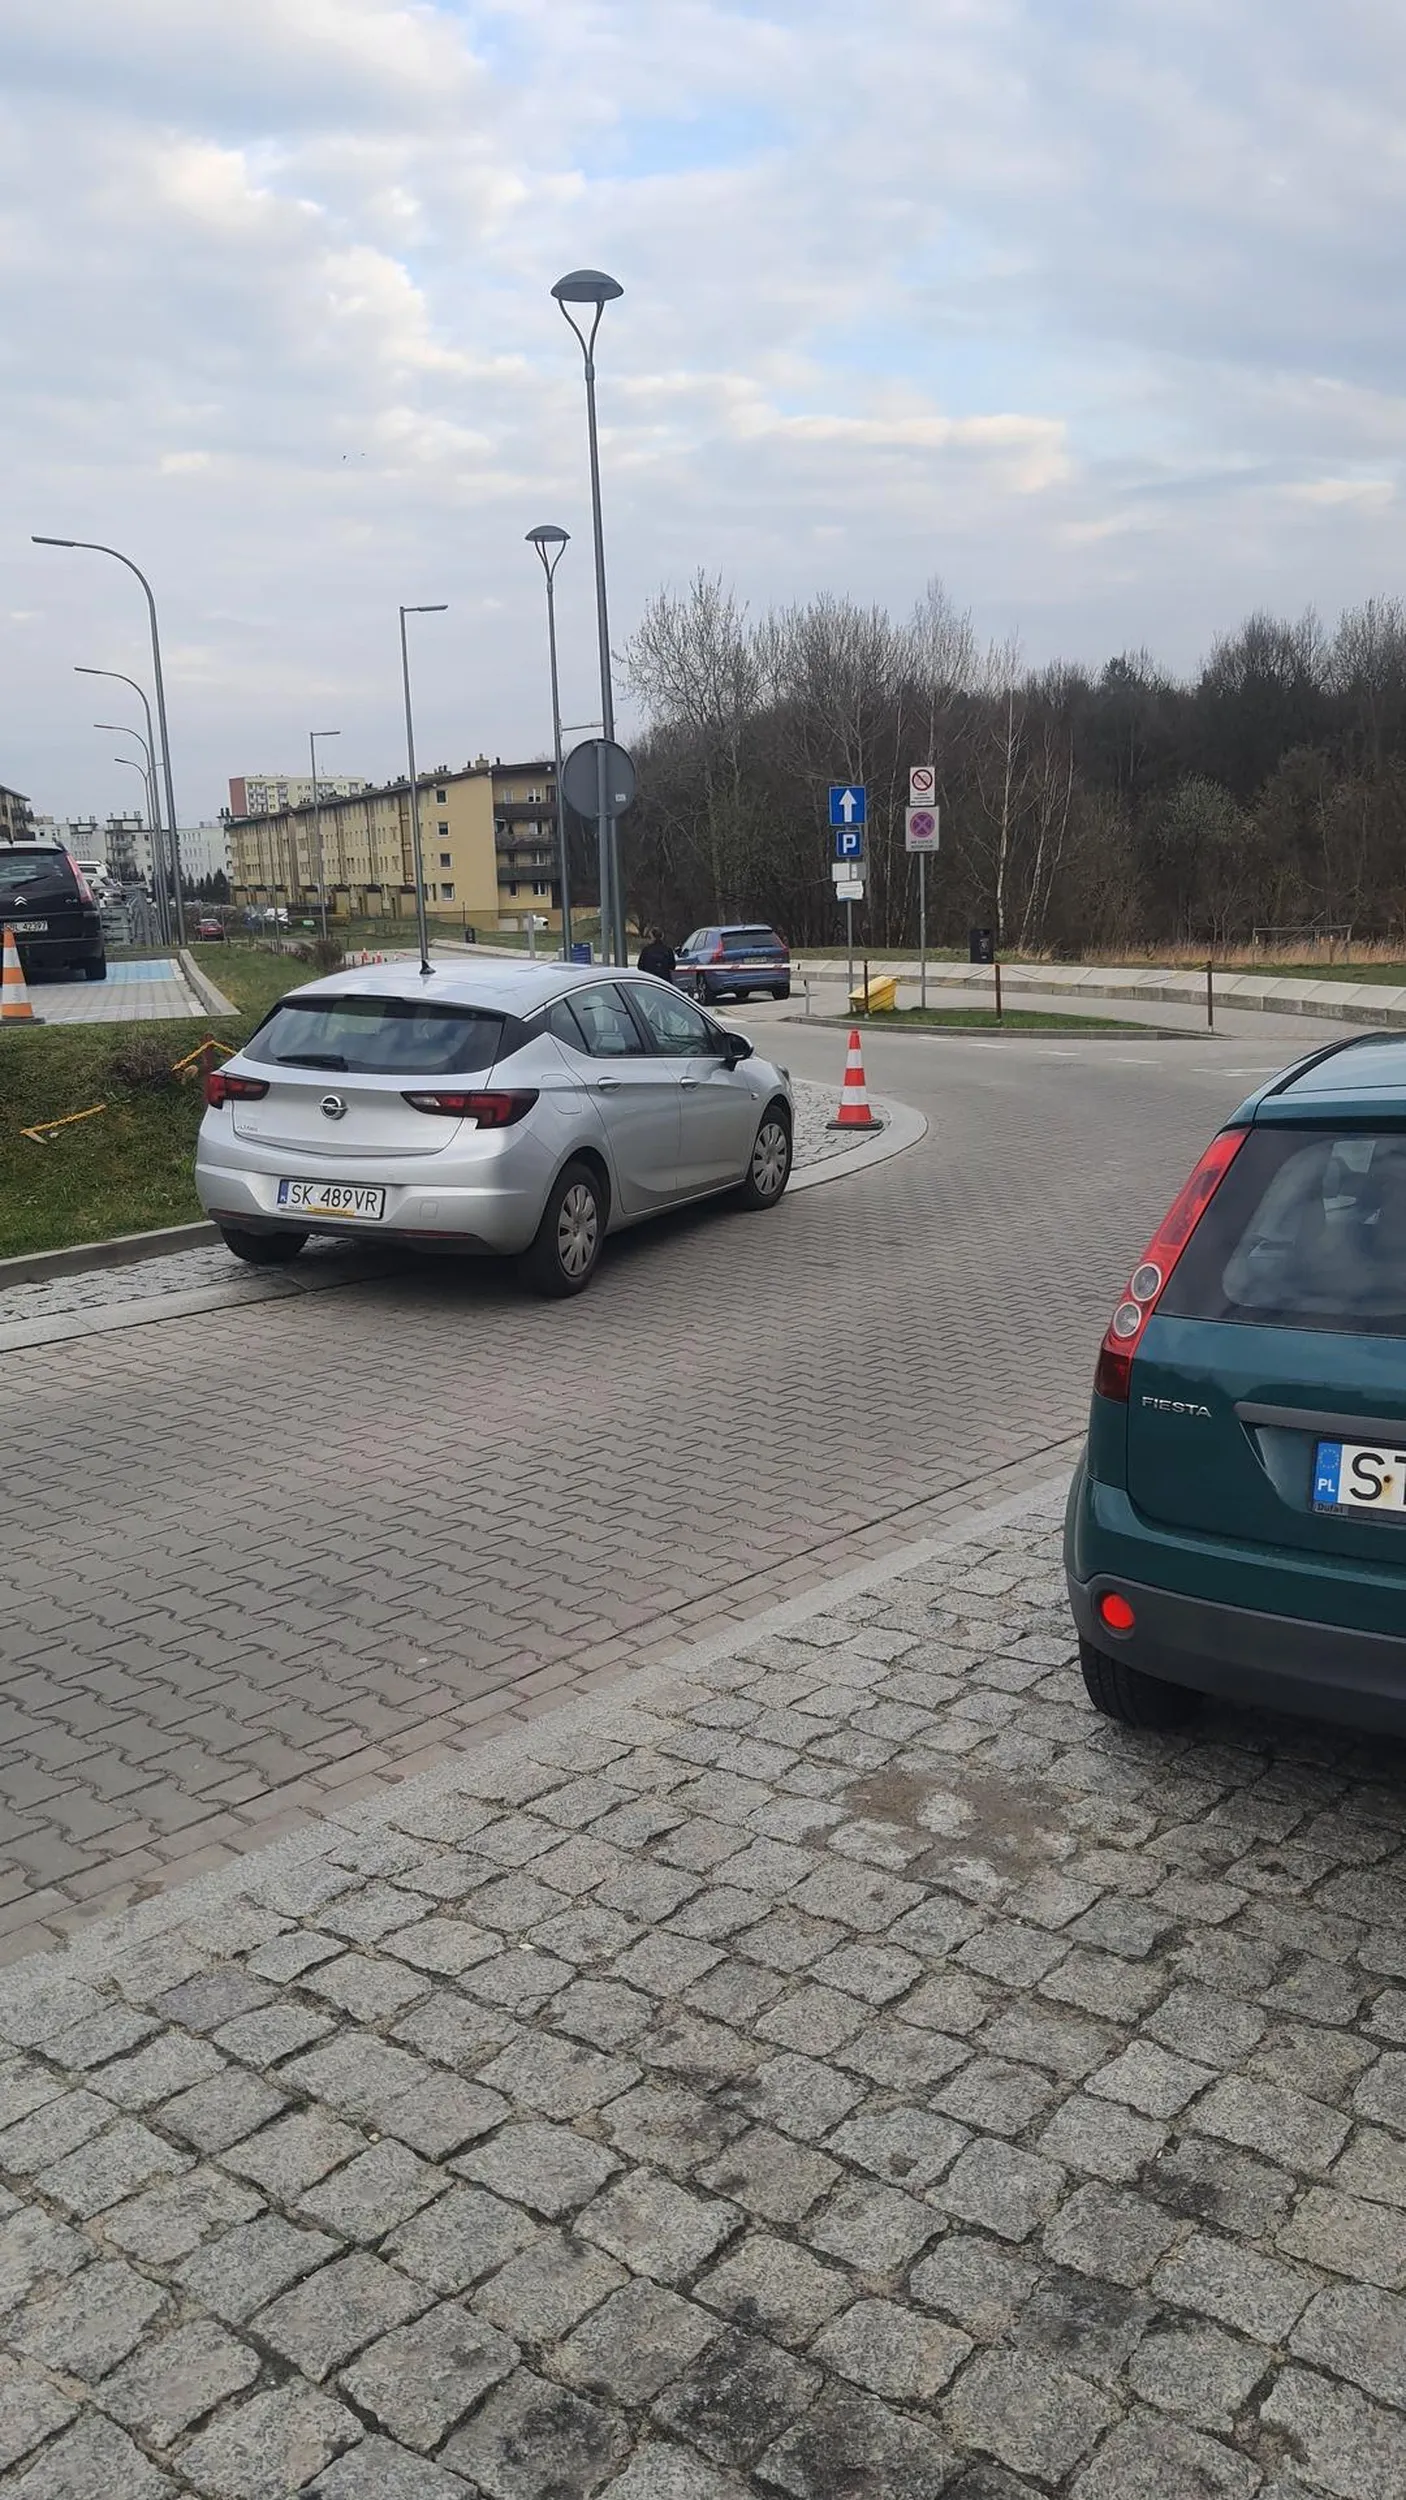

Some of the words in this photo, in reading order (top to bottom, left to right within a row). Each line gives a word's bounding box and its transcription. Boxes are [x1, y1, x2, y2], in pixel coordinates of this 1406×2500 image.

[842, 834, 857, 854] P
[291, 1184, 314, 1205] SK
[320, 1187, 377, 1212] 489VR
[1141, 1396, 1213, 1418] FIESTA
[1317, 1478, 1336, 1493] PL
